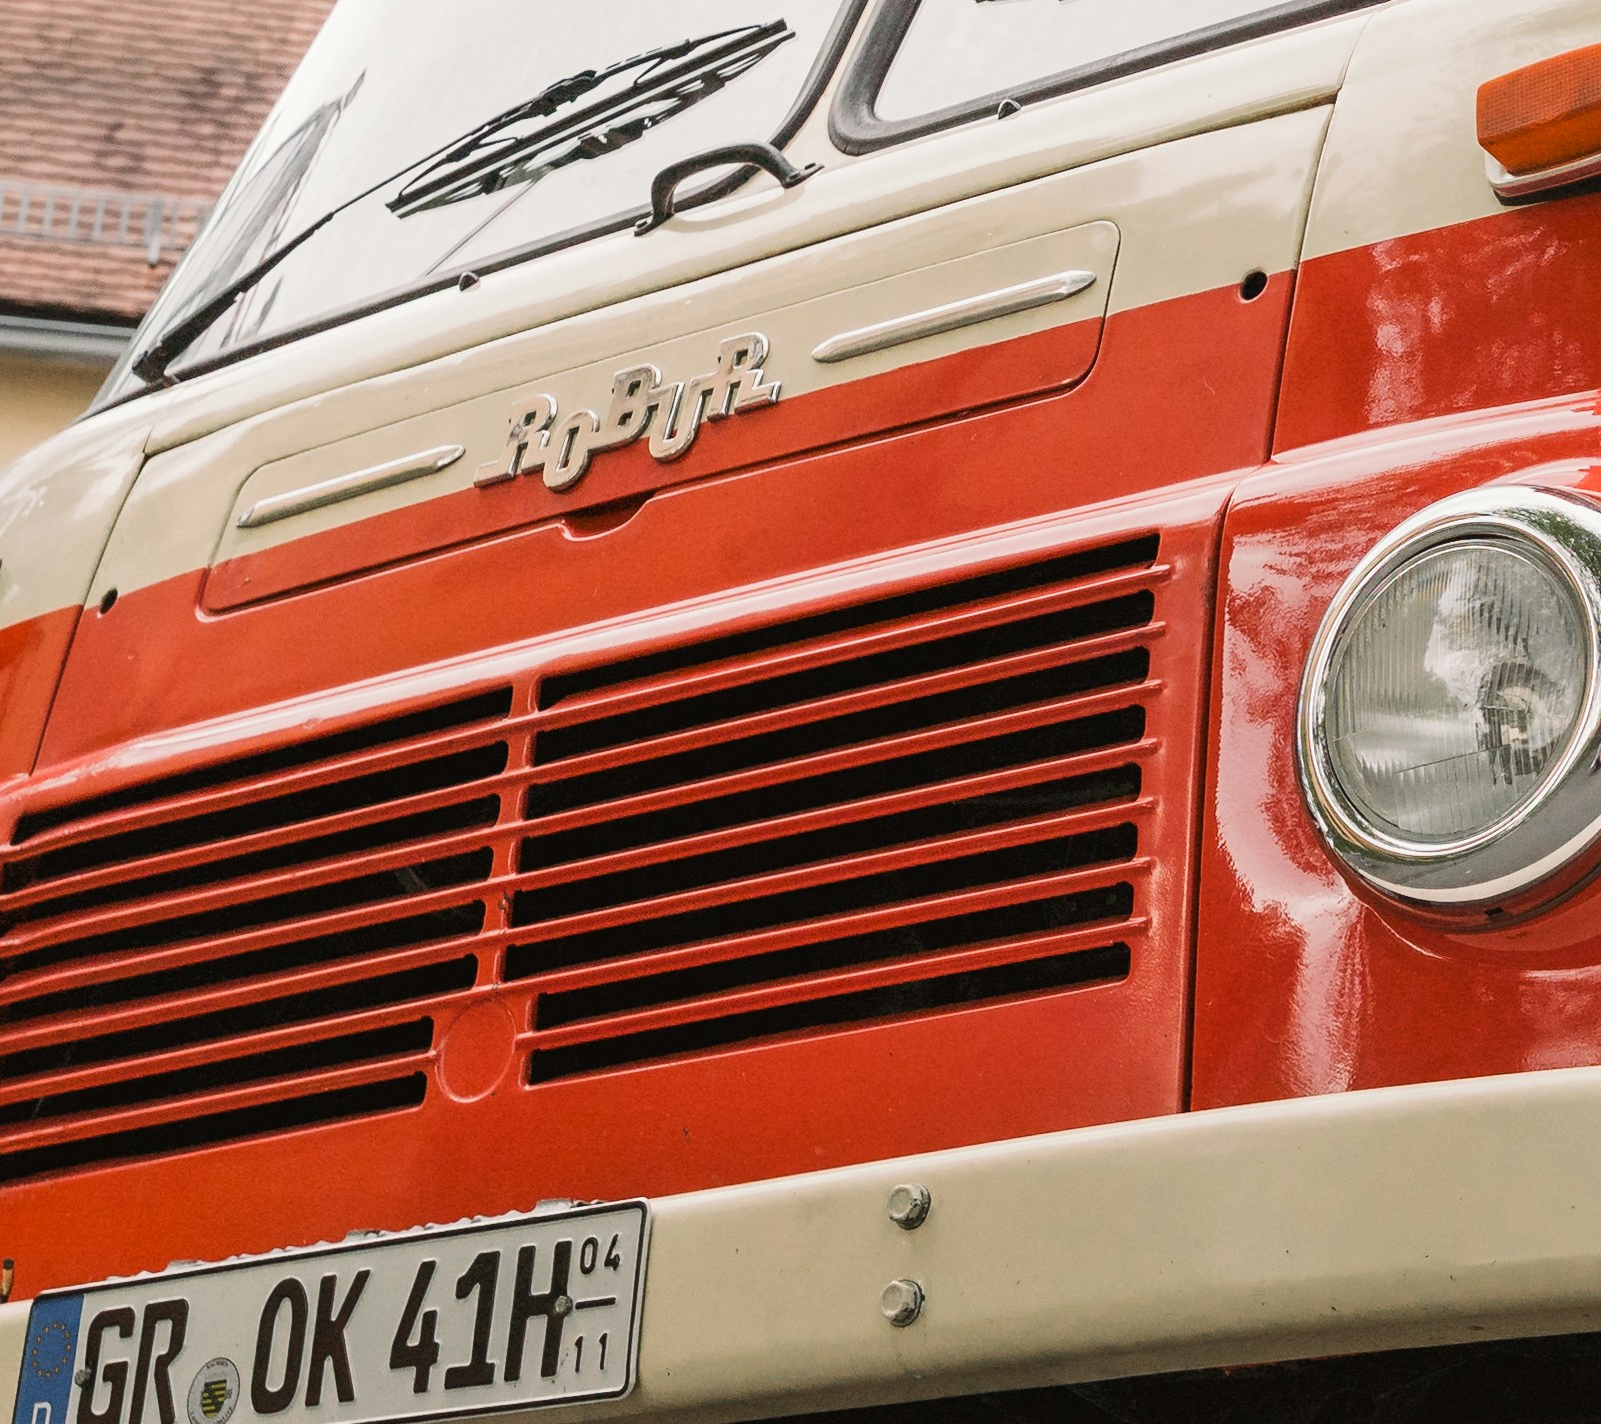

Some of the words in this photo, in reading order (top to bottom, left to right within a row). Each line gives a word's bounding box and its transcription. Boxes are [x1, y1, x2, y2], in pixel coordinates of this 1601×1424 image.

[579, 1233, 622, 1275] 04
[250, 1268, 372, 1416] OK
[388, 1239, 573, 1395] 41H
[574, 1332, 610, 1374] 11
